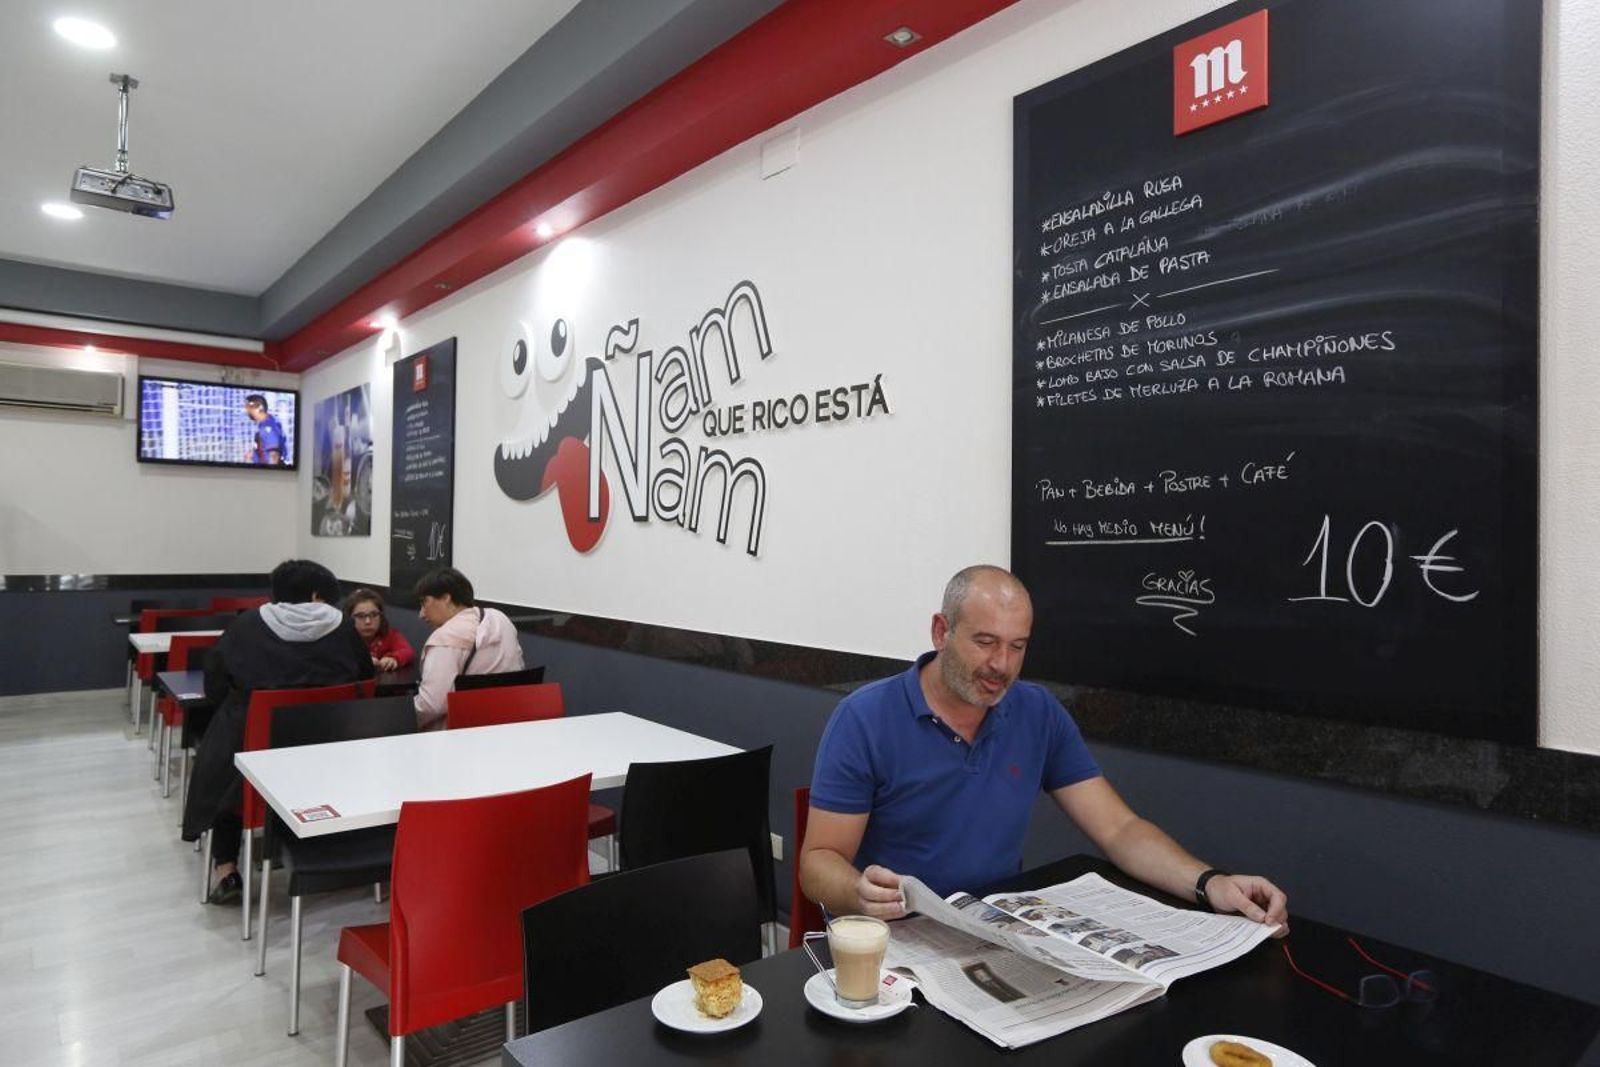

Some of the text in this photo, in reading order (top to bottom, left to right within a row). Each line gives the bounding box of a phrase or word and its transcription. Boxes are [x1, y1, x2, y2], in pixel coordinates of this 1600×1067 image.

[1143, 175, 1183, 198] RUSA
[1053, 194, 1202, 254] OREJA A LA GALLEGA
[1051, 258, 1088, 279] TOSTA
[1053, 251, 1211, 299] ENSALADA DE PASTA
[1117, 320, 1140, 335] DE
[1146, 313, 1186, 329] POLLO
[1120, 344, 1139, 357] DE
[1148, 331, 1218, 354] MORUNOS
[1086, 370, 1119, 382] BAJO
[1126, 363, 1153, 376] CON
[1160, 355, 1206, 372] SALSA
[1216, 350, 1236, 366] DE
[1103, 388, 1122, 400] DE
[1129, 378, 1199, 398] MERLUZA
[1208, 377, 1220, 391] A
[1228, 376, 1252, 390] LA
[1263, 366, 1346, 388] ROMANA
[703, 373, 890, 438] QUE RICO ESTÁ
[1159, 470, 1212, 494] POSTRE
[1290, 514, 1480, 608] 10 €
